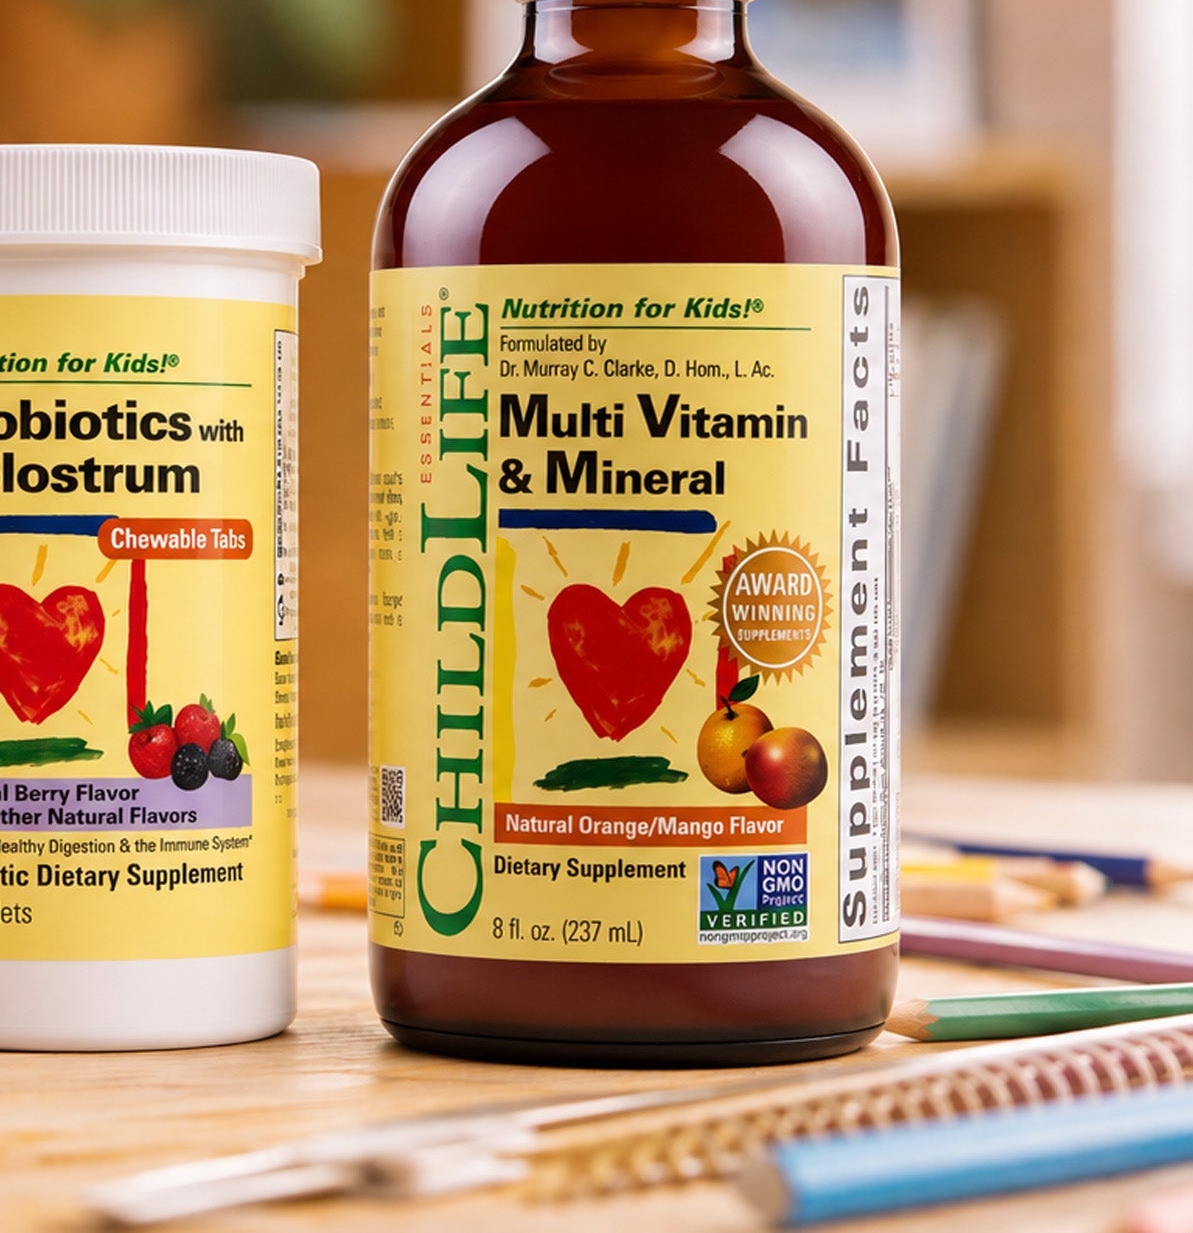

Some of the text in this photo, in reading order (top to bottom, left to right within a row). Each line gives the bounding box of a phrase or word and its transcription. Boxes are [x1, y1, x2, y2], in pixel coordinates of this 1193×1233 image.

[501, 298, 624, 319] Nutrition
[634, 297, 676, 319] for
[500, 334, 607, 355] Formulated by
[57, 352, 97, 373] for
[500, 360, 775, 381] Dr. Murray C. Clarke, D. Hom., L. Ac.
[421, 304, 432, 484] ESSENTIALS
[500, 394, 808, 439] Multi Vitamin
[199, 419, 244, 442] with
[498, 450, 725, 495] & Mineral
[110, 527, 246, 549] Chewable Tabs
[735, 572, 813, 596] AWARD
[731, 604, 816, 622] WINNING
[842, 286, 870, 928] Supplement Facts
[15, 784, 70, 805] Berry
[76, 784, 140, 801] Flavor
[48, 807, 123, 825] Natural
[130, 807, 197, 824] Flavors
[506, 814, 784, 839] Natural Orange/Mango Flavor
[49, 838, 115, 857] Digestion
[119, 839, 131, 853] &
[135, 838, 156, 853] the
[160, 837, 209, 852] Immune
[37, 864, 120, 891] Dietary
[126, 861, 244, 891] Supplement
[494, 855, 686, 883] Dietary Supplement
[763, 859, 804, 875] NON
[762, 875, 804, 893] GMO
[706, 911, 804, 928] VERIFIED
[492, 917, 644, 946] 8 fl. oz. (237 mL)
